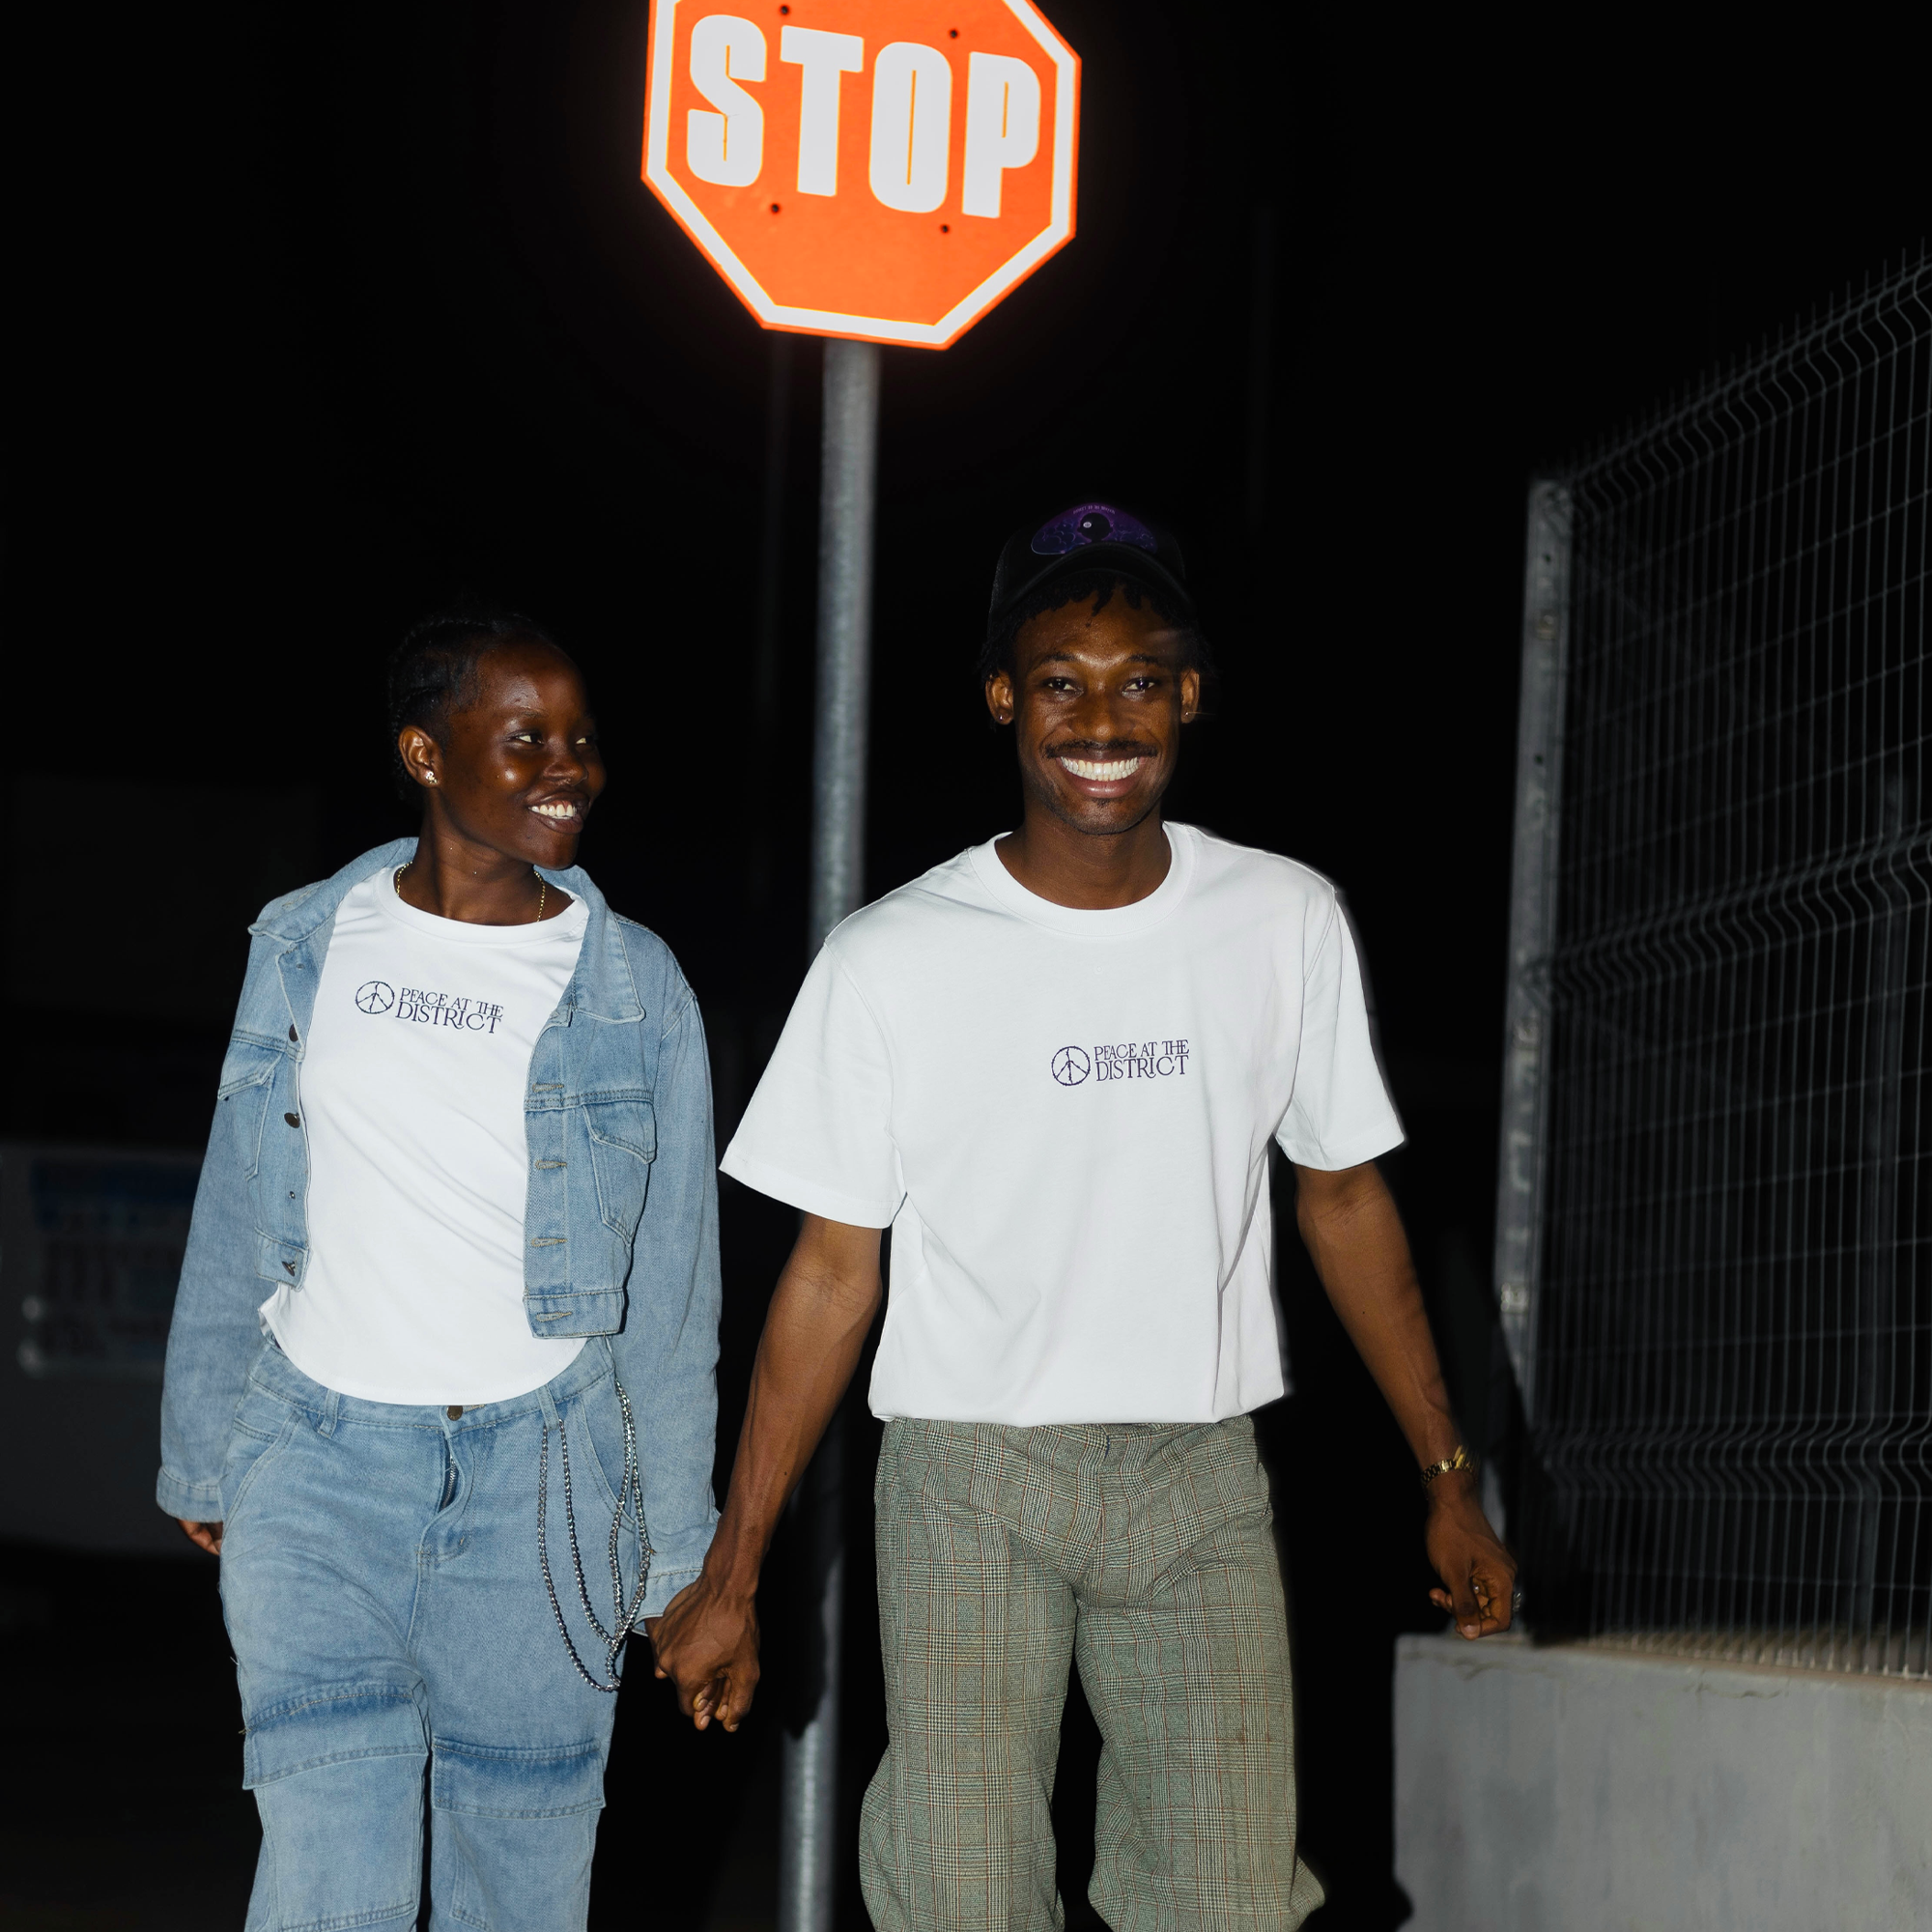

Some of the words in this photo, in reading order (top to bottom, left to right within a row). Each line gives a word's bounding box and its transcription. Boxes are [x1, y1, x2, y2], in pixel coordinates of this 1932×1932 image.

[687, 14, 1040, 218] STOP
[395, 1002, 501, 1034] DISTRICT
[400, 987, 448, 1007] PEACE
[451, 997, 471, 1011] AT
[476, 1001, 503, 1018] THE
[1094, 1044, 1137, 1061] PEACE
[1141, 1041, 1157, 1057] AT
[1162, 1039, 1189, 1055] THE
[1095, 1055, 1189, 1081] DISTRICT
